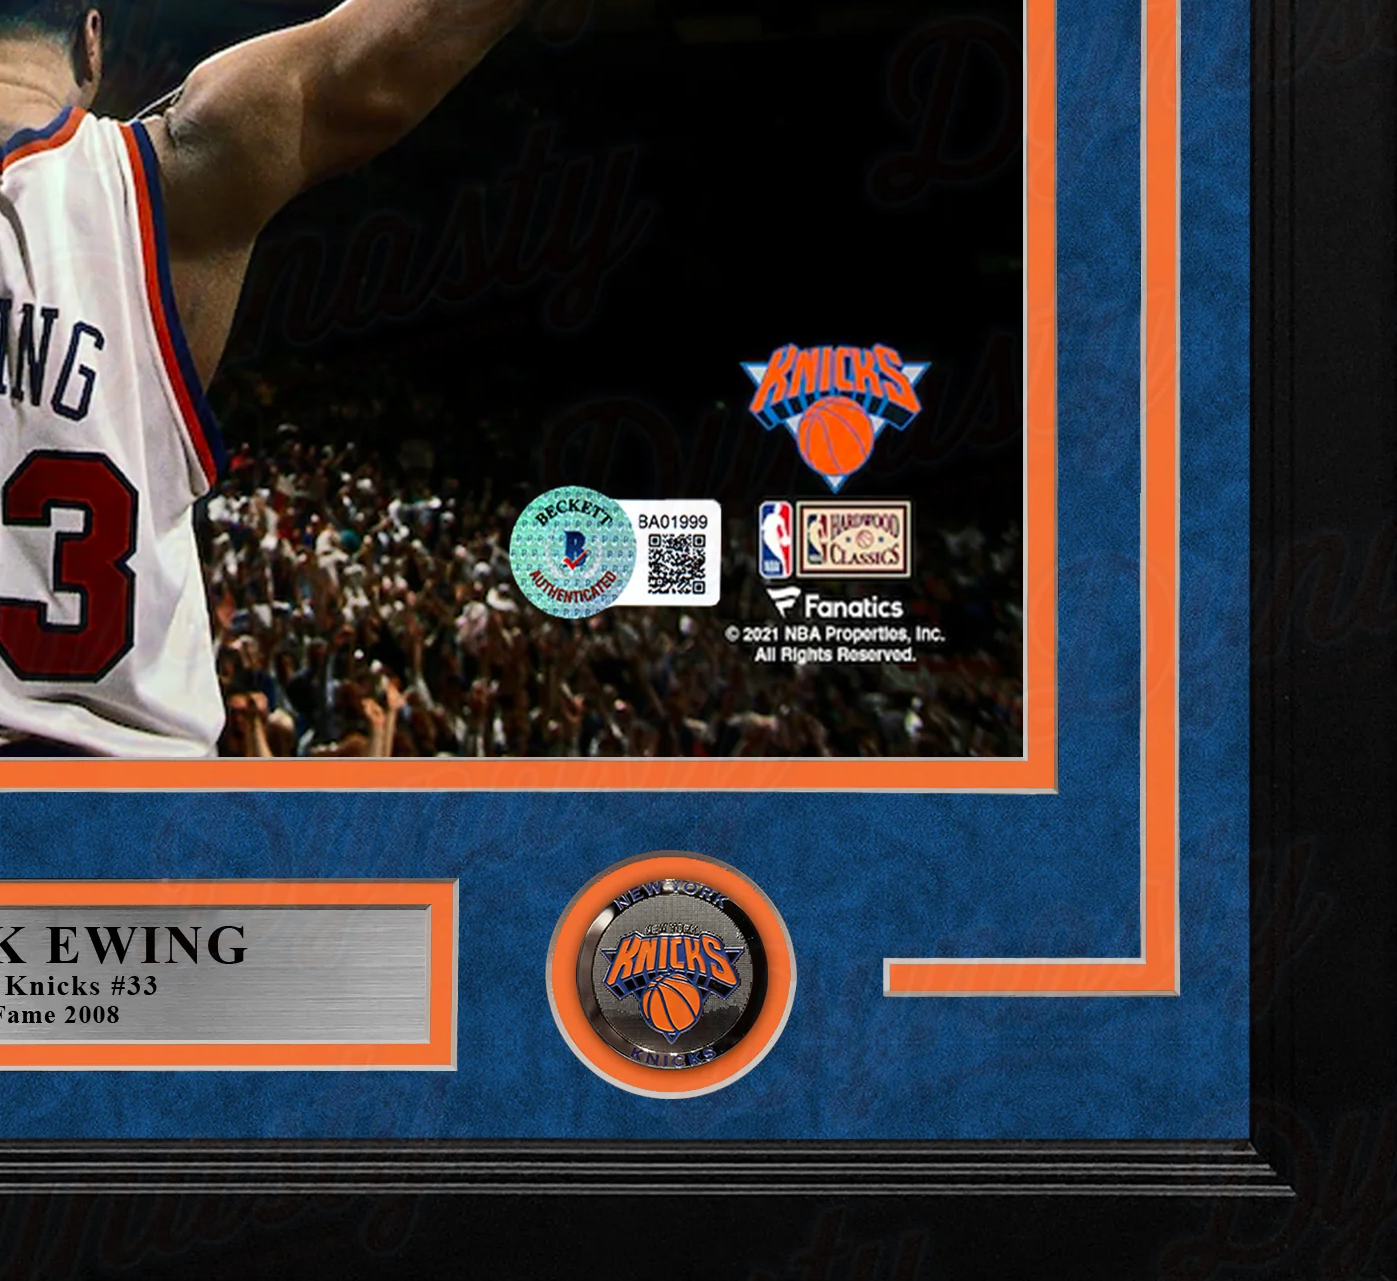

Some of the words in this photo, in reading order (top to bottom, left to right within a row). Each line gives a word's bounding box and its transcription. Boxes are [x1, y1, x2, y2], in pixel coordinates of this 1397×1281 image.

[750, 342, 922, 415] KNICKS
[534, 498, 614, 527] BECKETT
[638, 514, 709, 530] BA01999
[830, 513, 902, 541] HARDWOOD
[830, 543, 902, 566] CLASSICS
[529, 569, 618, 604] AUTHENTICATED
[805, 593, 904, 618] Fanatics
[742, 626, 779, 642] 2021
[784, 625, 822, 642] NBA
[825, 625, 912, 645] Properties,
[915, 625, 946, 642] Inc.
[754, 646, 776, 662] All
[780, 646, 833, 666] Rights
[836, 646, 917, 662] Reserved.
[615, 880, 663, 910] NEW
[672, 879, 726, 908] YORK
[45, 925, 248, 965] EWING
[606, 933, 739, 987] KNICKS
[4, 975, 100, 996] Knicks
[111, 975, 157, 996] #33
[64, 1005, 120, 1024] 2008
[630, 1046, 717, 1068] KNICKS
